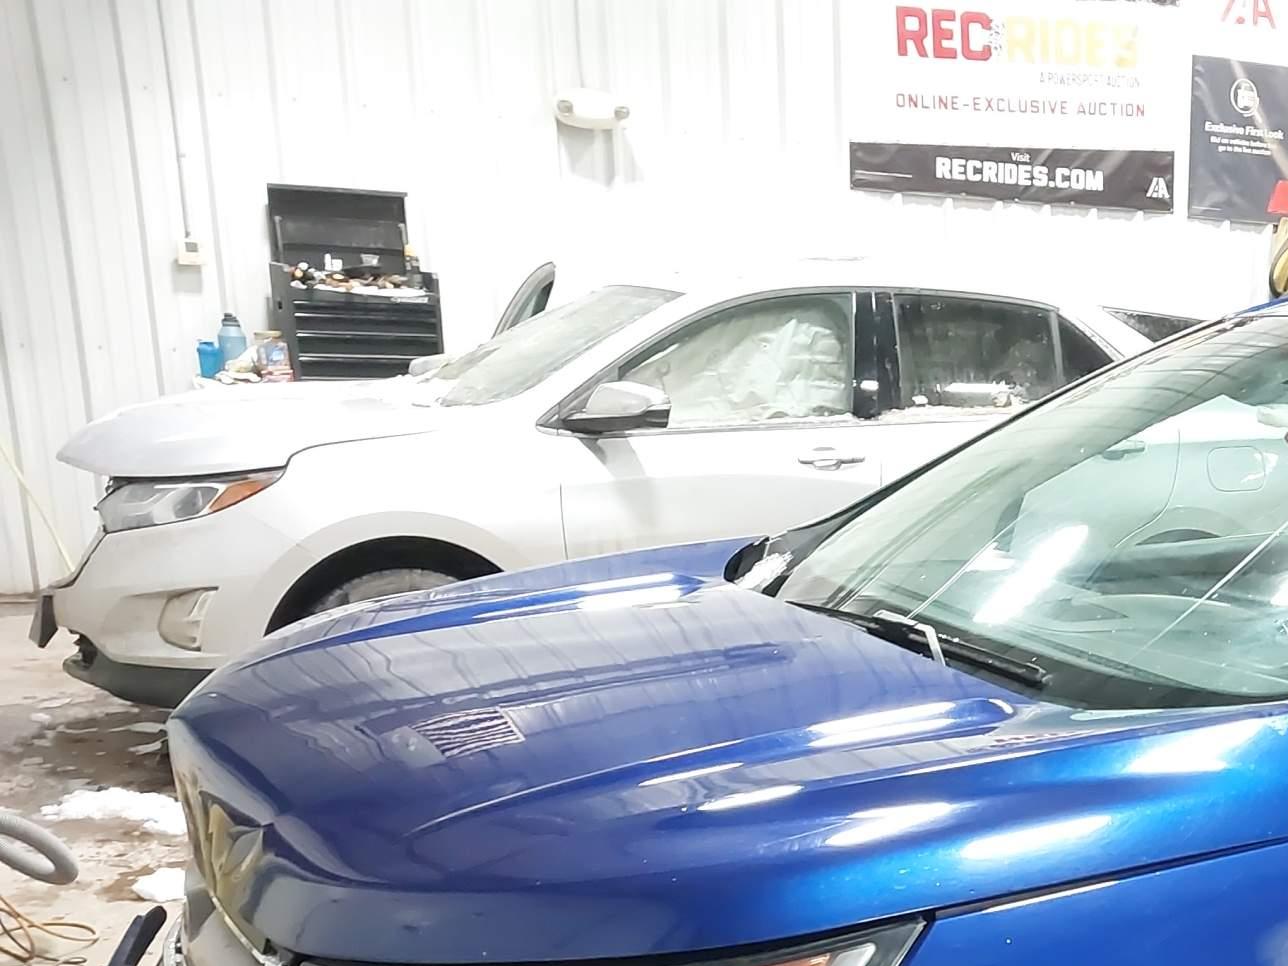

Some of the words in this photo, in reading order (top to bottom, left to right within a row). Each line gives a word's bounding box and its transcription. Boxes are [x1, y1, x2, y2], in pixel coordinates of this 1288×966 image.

[896, 93, 1068, 114] ONLINE-EXCLUSIVE
[1077, 102, 1145, 117] AUCTION
[1011, 152, 1031, 163] Visit
[935, 157, 1104, 191] RECRIDES.COM
